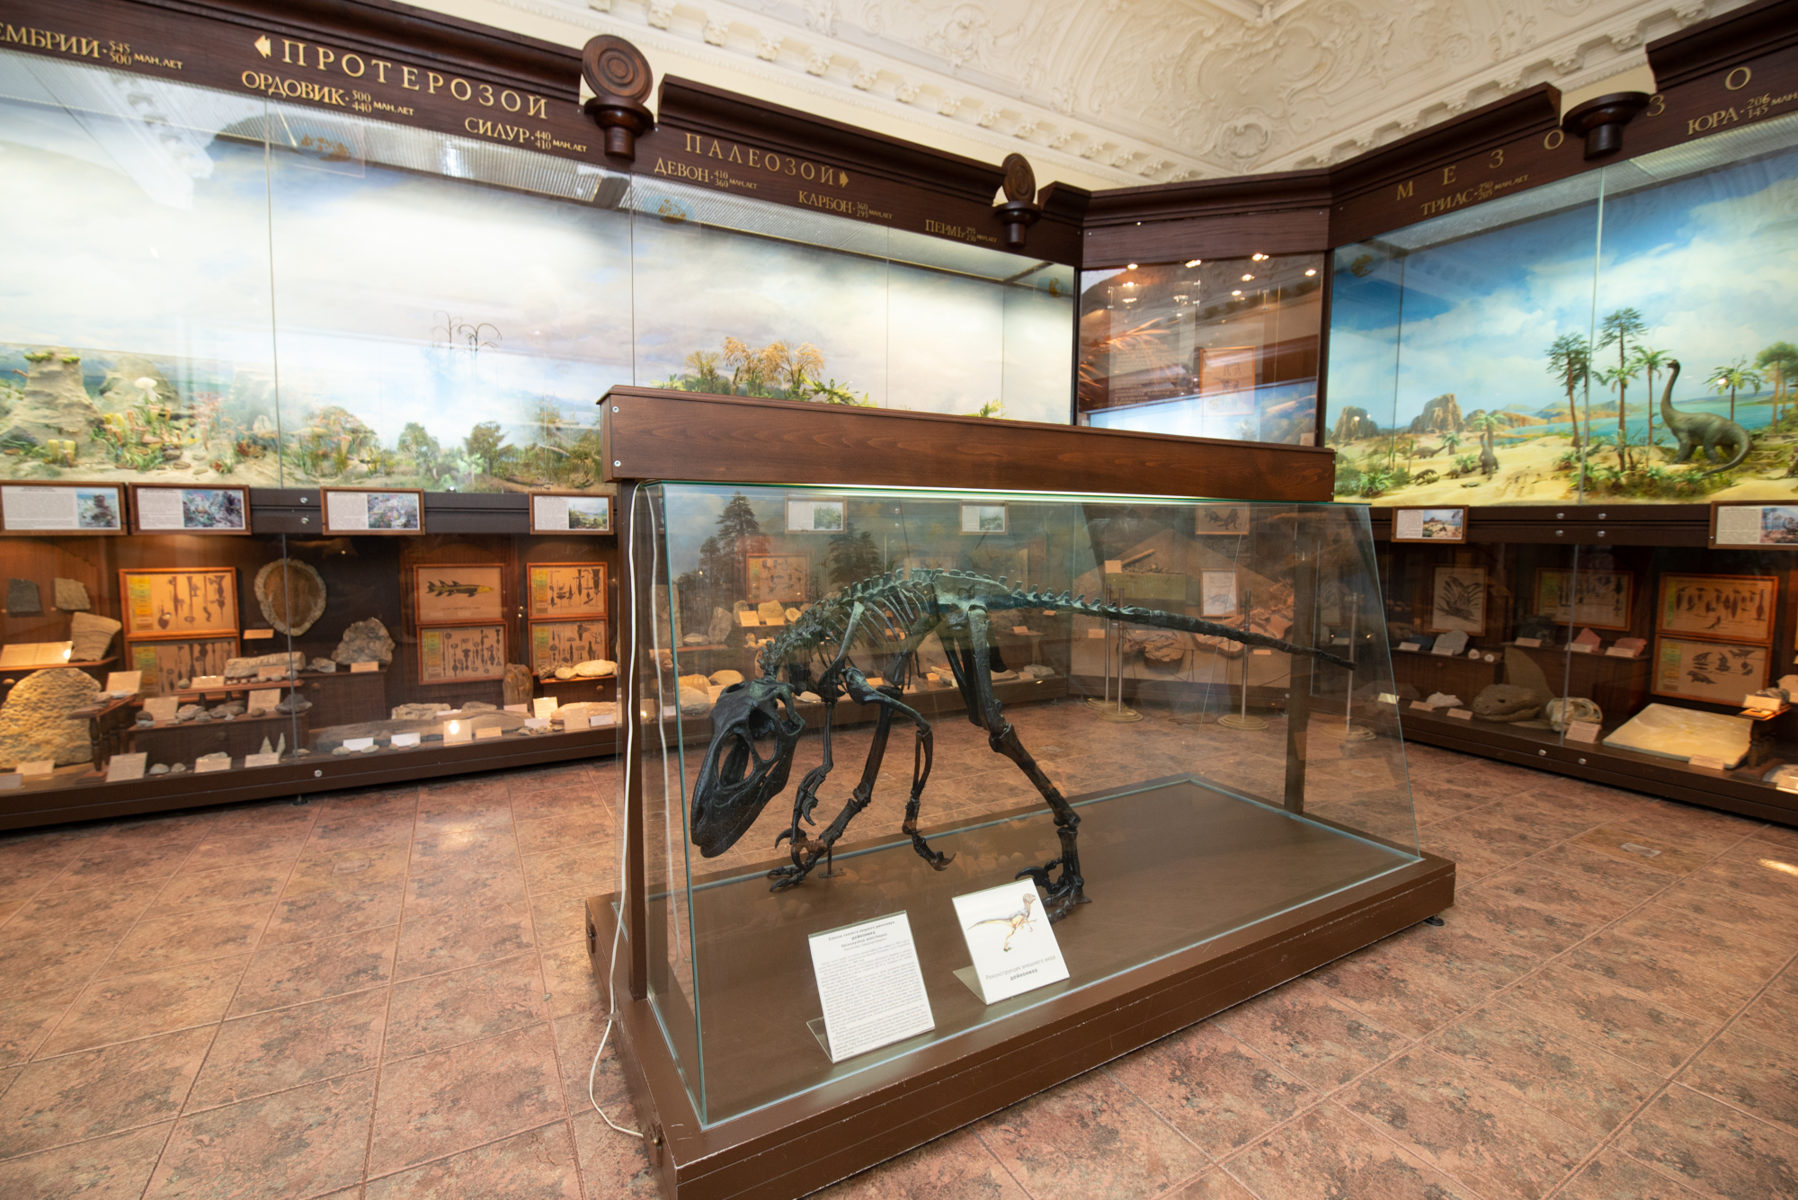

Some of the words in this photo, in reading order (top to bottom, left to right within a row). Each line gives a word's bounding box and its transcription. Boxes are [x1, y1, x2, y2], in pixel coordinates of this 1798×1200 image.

[241, 70, 347, 107] ОРДОВИК
[281, 38, 548, 120] ПРОТЕРОЗОЙ
[464, 117, 530, 143] СИЛУР
[1687, 107, 1739, 135] ЮРА
[654, 157, 710, 183] ДЕВОН
[684, 132, 836, 186] ПАЛЕОЗОЙ
[798, 190, 853, 214] КАРБОН
[1420, 187, 1475, 216] ТРИАС
